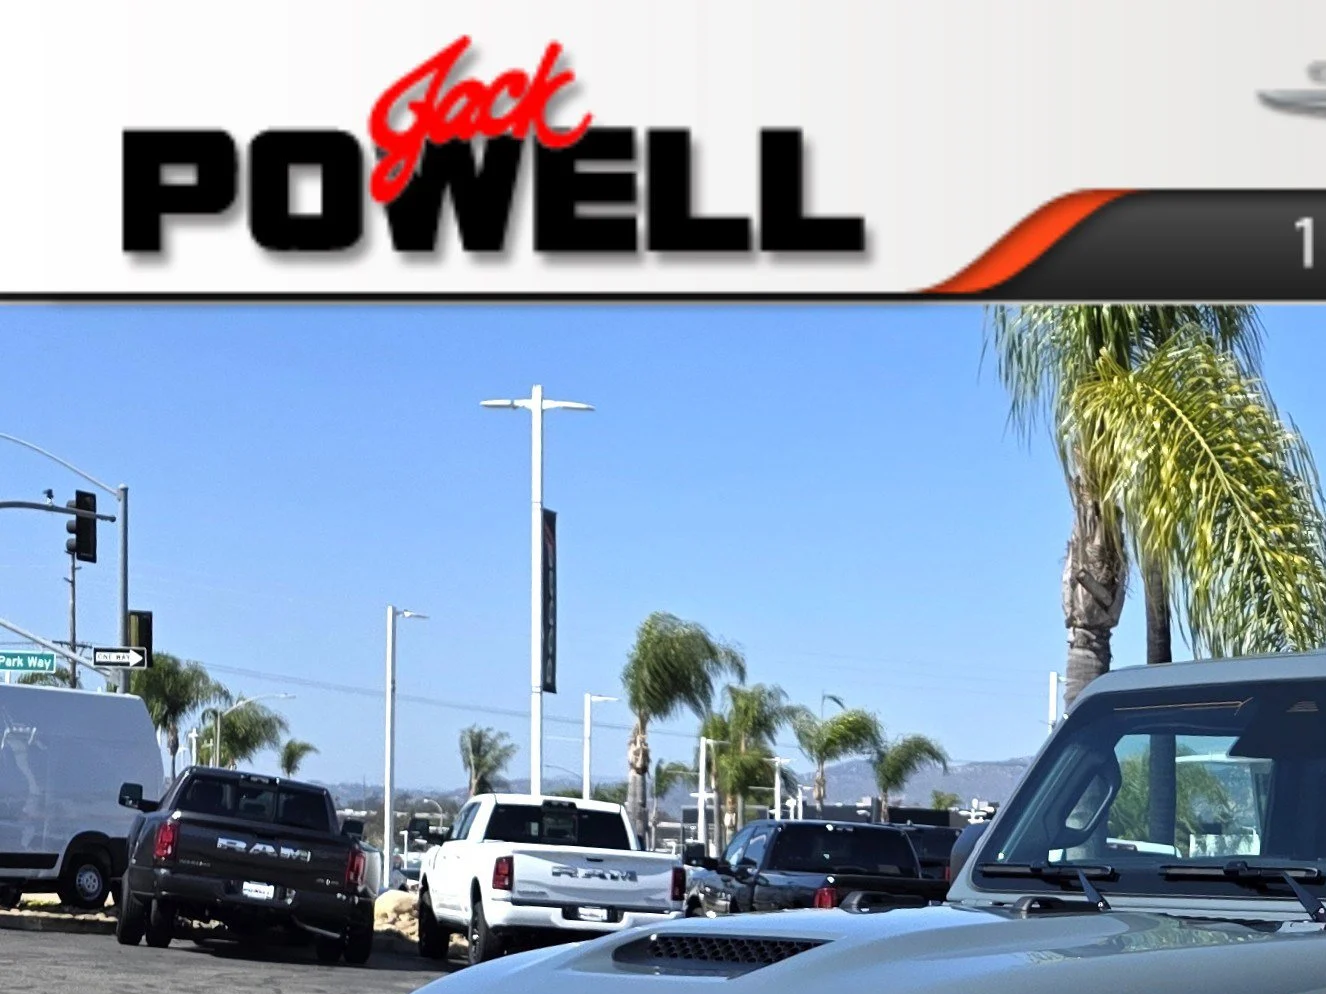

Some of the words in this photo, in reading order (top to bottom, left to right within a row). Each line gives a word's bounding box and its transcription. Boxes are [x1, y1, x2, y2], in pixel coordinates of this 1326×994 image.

[0, 655, 24, 667] Park
[28, 656, 51, 671] Way
[217, 837, 311, 862] RAM
[551, 866, 638, 882] RAM
